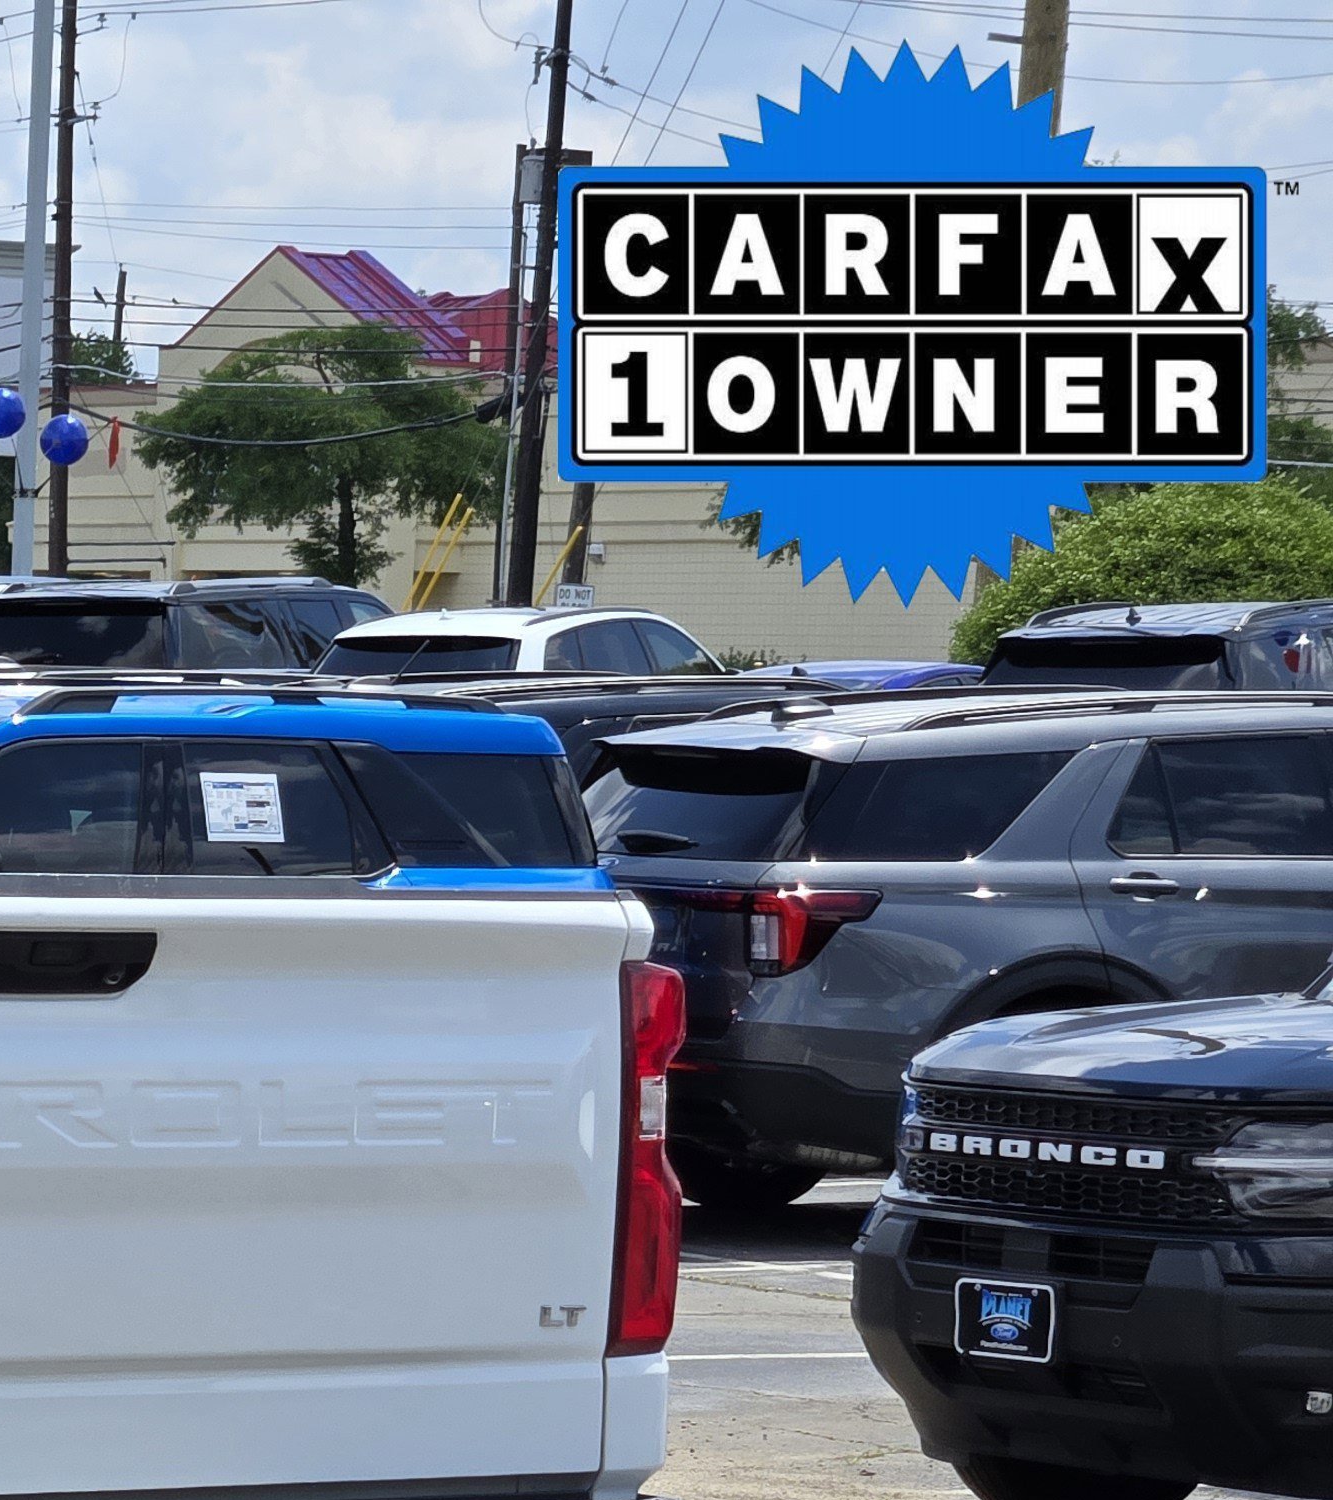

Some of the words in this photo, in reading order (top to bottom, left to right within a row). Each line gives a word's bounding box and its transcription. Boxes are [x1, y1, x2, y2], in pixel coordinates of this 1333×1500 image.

[559, 588, 571, 599] DO
[574, 589, 591, 600] NOT
[929, 1132, 1166, 1170] BRONCO
[539, 1305, 587, 1327] LT
[981, 1289, 1032, 1323] PLANET
